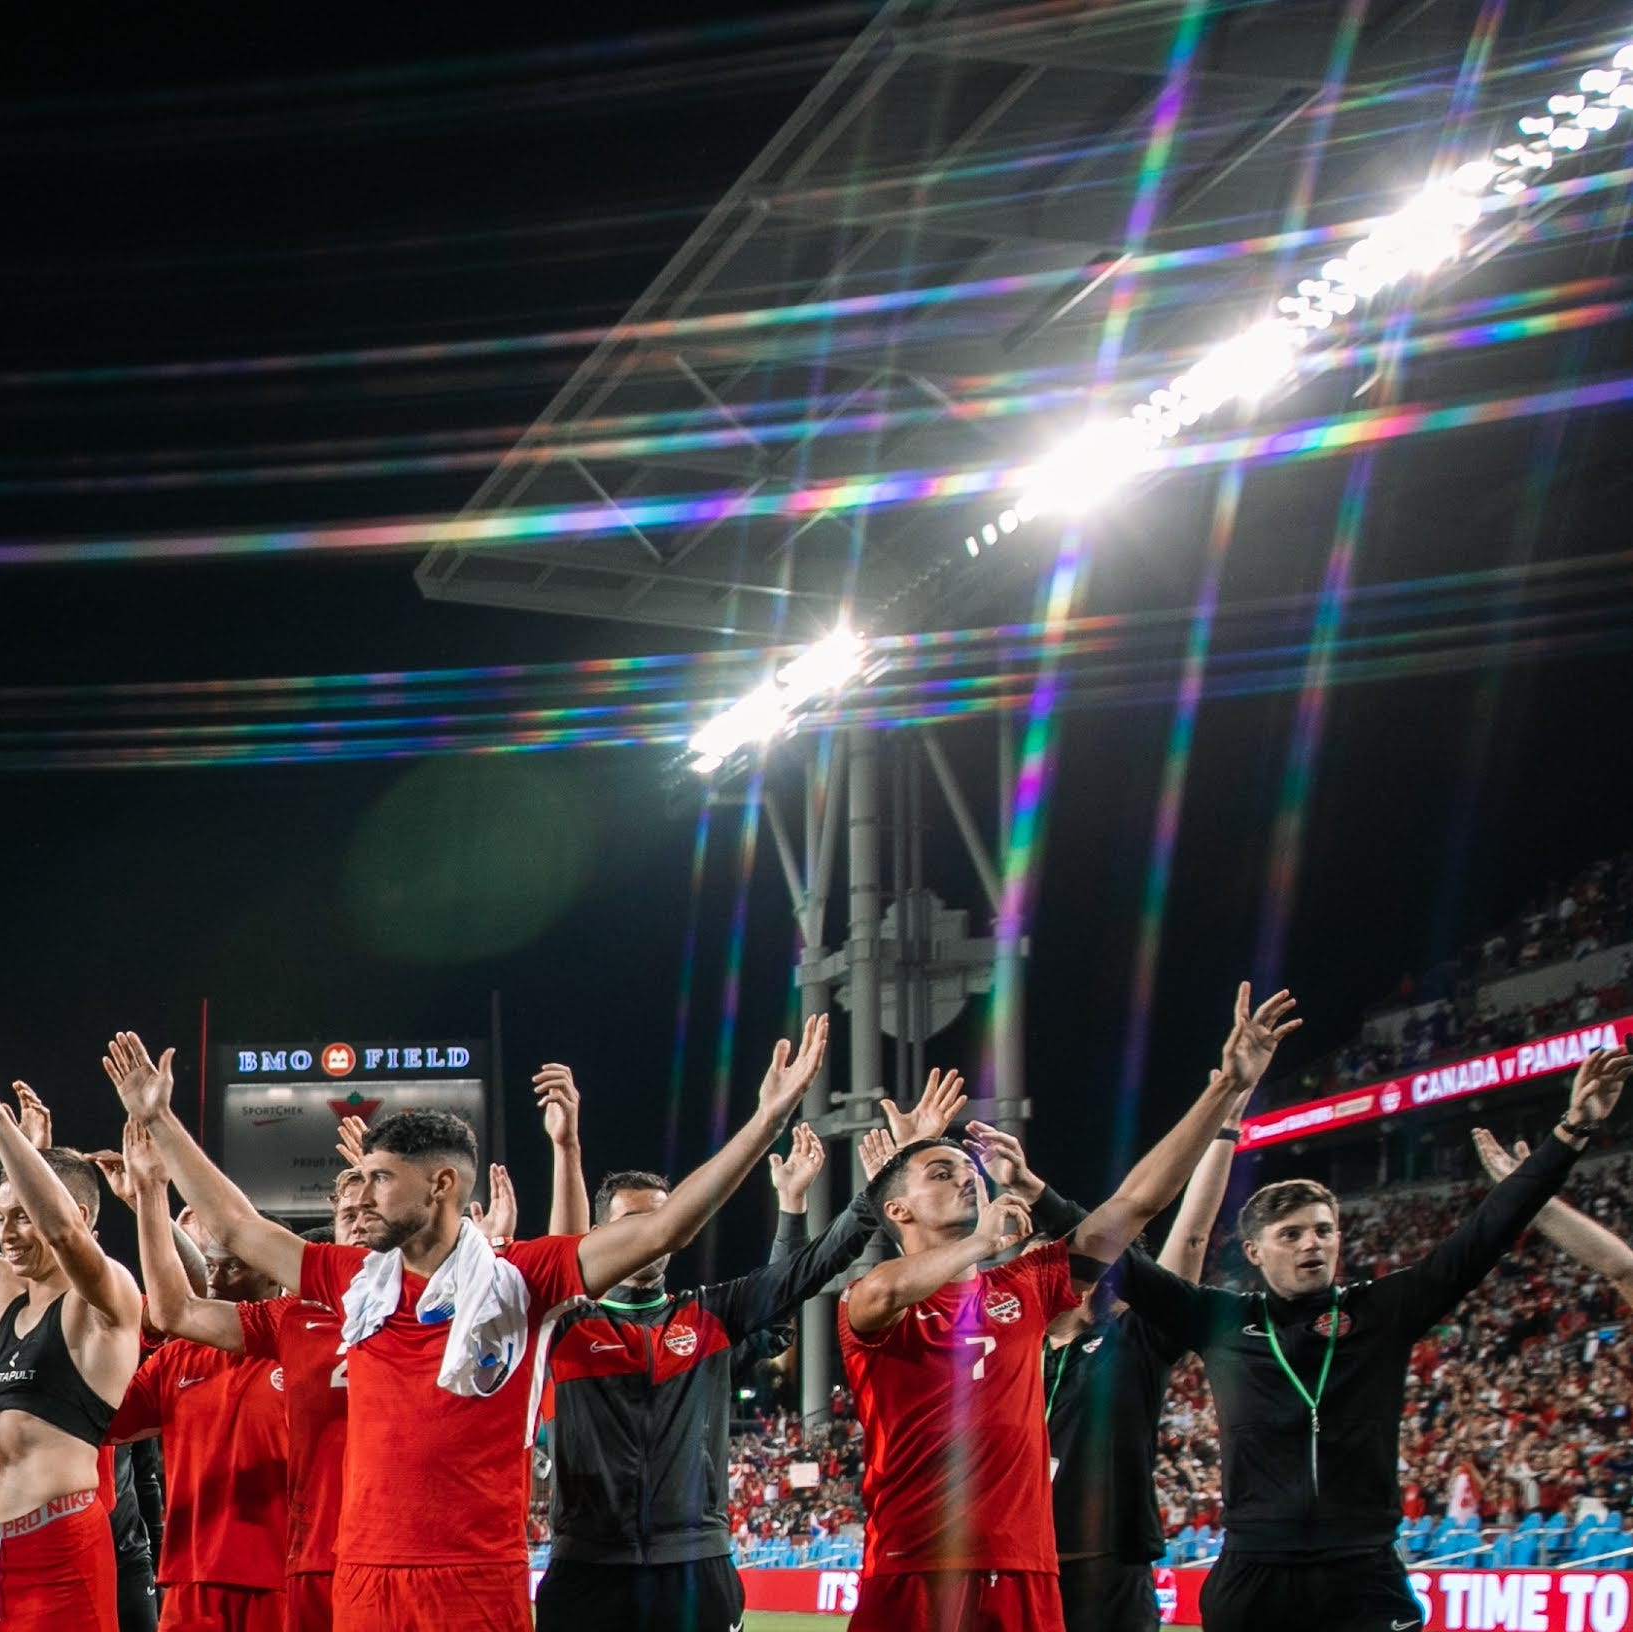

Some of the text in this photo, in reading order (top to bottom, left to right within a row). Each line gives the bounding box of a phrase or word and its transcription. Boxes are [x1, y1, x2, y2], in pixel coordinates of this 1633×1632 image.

[238, 1046, 471, 1072] BMO FIELD
[1411, 1056, 1500, 1104] CANADA
[1516, 1024, 1618, 1078] PANAMA
[988, 1300, 1019, 1315] CANADA
[965, 1336, 997, 1380] 7
[1, 1508, 41, 1539] PRO
[817, 1571, 860, 1612] IT'S
[1439, 1573, 1553, 1632] TIME
